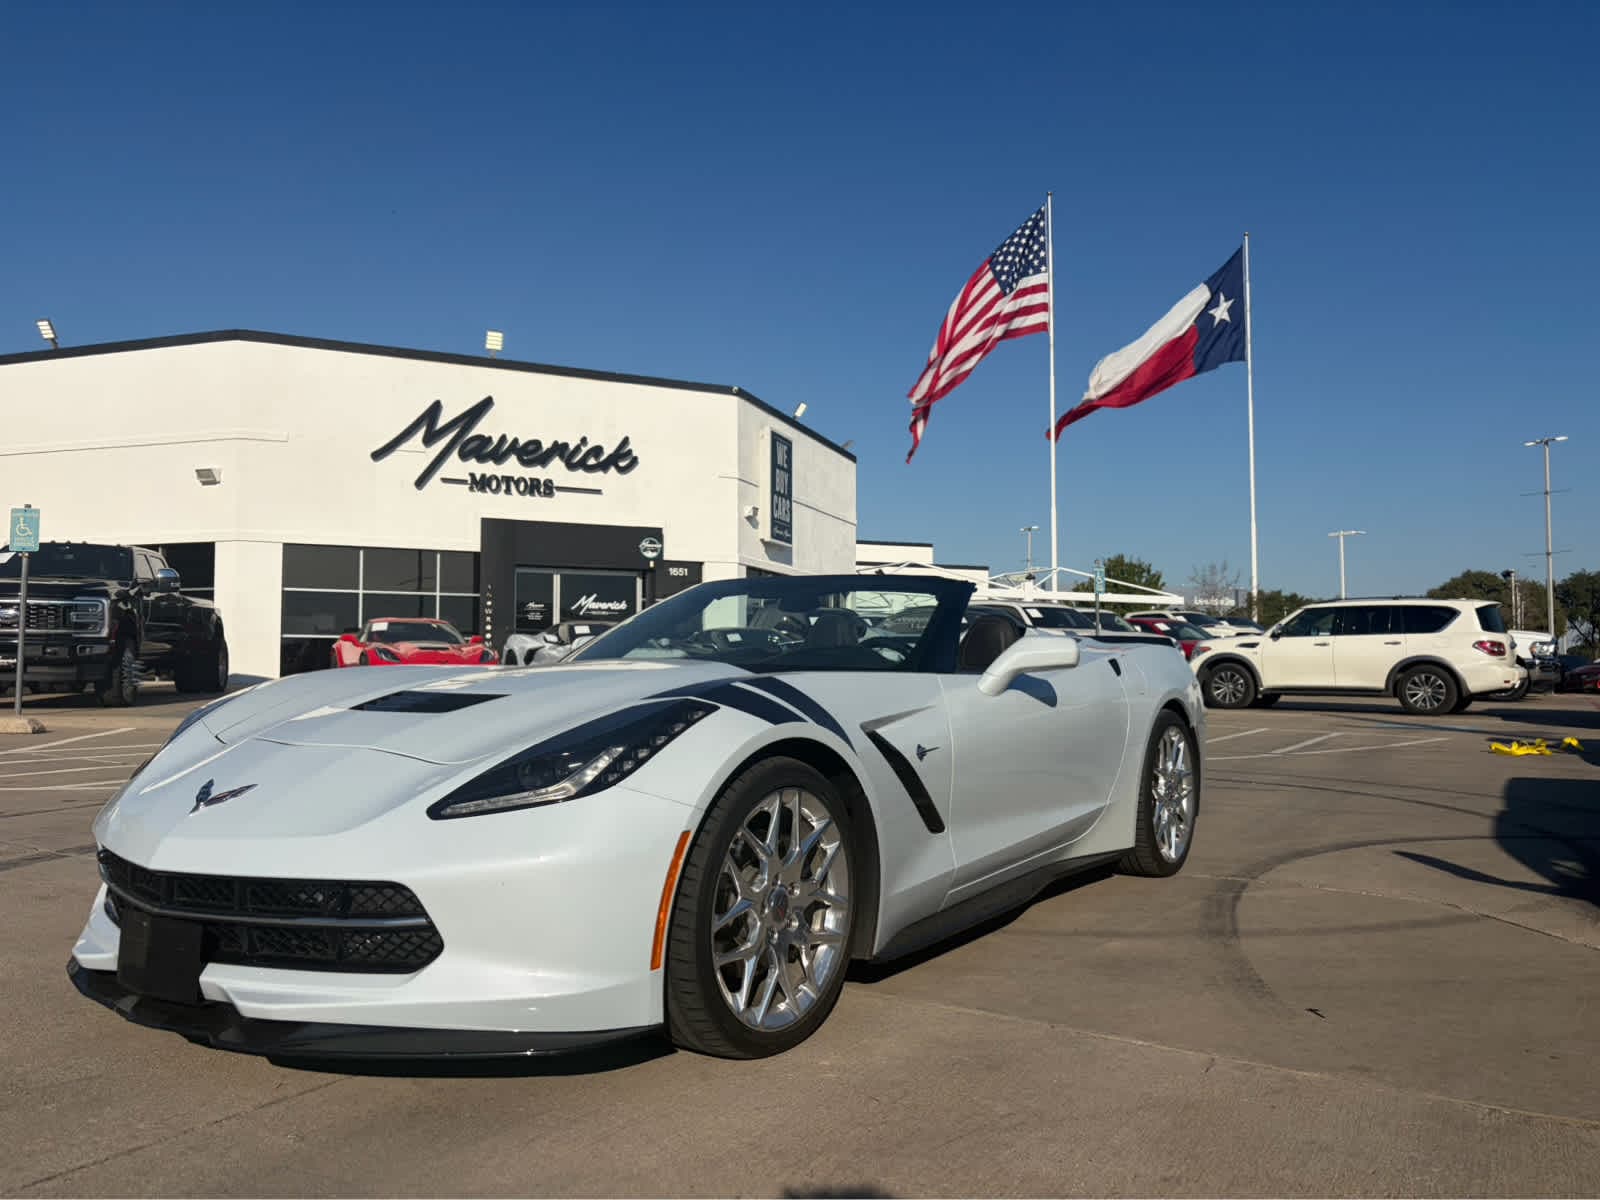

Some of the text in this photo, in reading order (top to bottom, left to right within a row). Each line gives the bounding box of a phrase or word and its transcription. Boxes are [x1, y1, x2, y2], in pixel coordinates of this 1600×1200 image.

[370, 395, 640, 490] Maverick
[468, 472, 556, 498] MOTORS
[669, 567, 688, 576] 1651
[571, 593, 628, 615] Maverick
